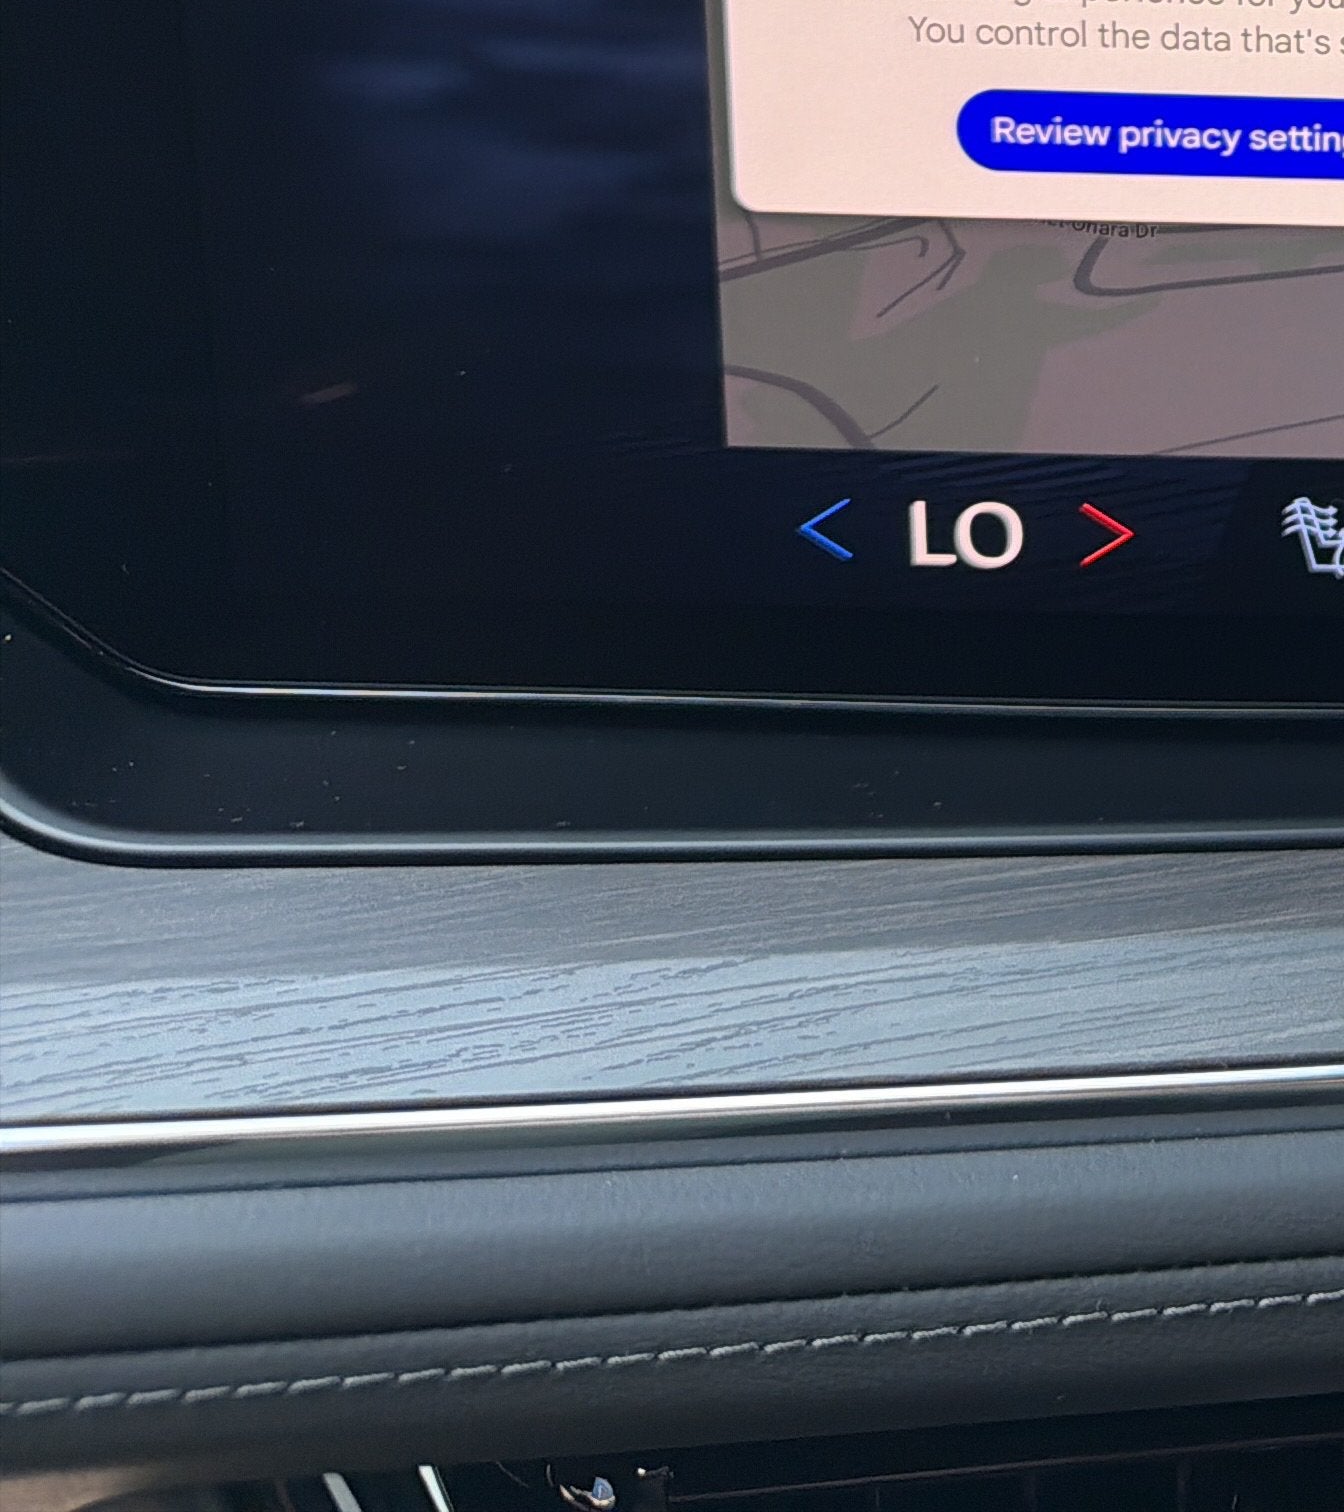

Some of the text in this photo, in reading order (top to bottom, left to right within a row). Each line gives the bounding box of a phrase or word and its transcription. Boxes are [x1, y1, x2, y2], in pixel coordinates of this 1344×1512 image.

[908, 16, 964, 43] You
[976, 20, 1086, 47] control
[1098, 21, 1150, 49] the
[1161, 23, 1230, 51] data
[1241, 25, 1330, 55] that's
[995, 117, 1110, 145] Review
[1121, 120, 1240, 155] privacy
[1136, 223, 1157, 238] Dr
[911, 501, 1023, 568] LO
